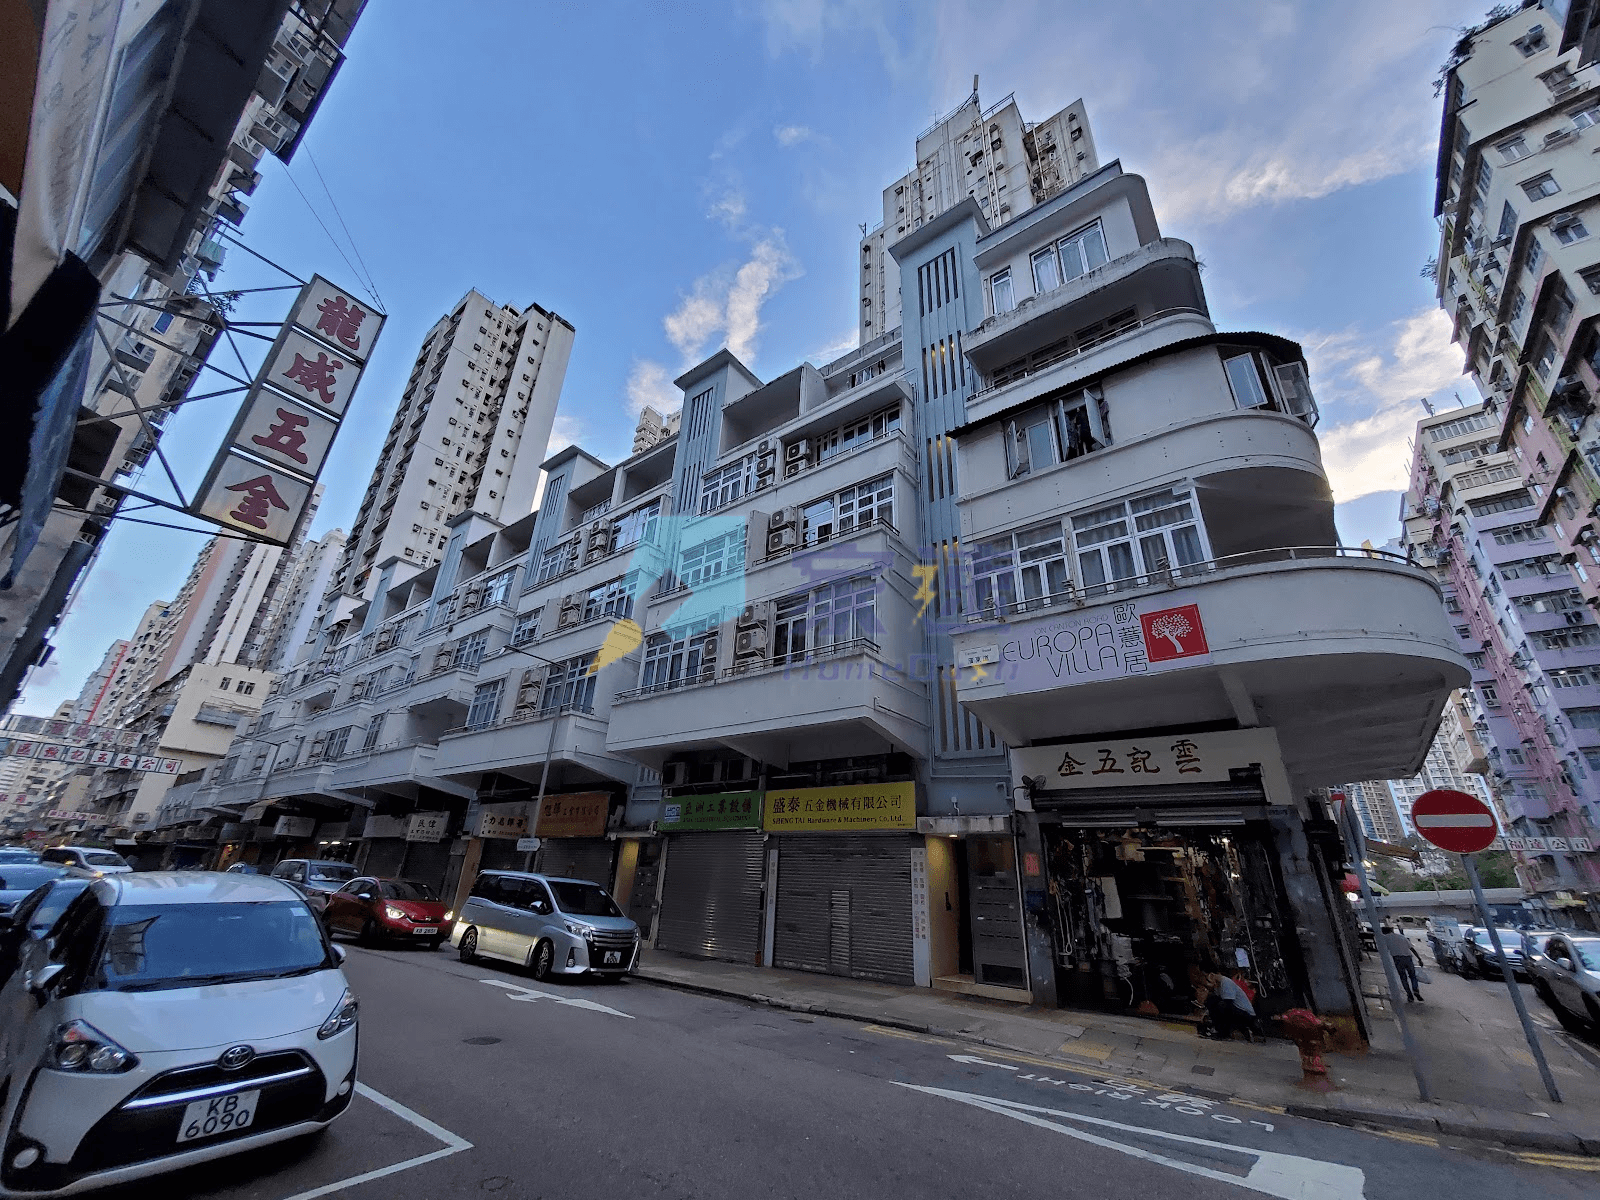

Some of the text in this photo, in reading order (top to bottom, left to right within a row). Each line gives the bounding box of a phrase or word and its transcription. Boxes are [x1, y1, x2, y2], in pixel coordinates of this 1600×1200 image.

[225, 295, 367, 530] 龍威五金
[1034, 627, 1047, 636] ON
[1048, 618, 1082, 632] CANTON
[1002, 622, 1116, 663] EUROPA
[1046, 645, 1120, 678] VILLA
[773, 795, 902, 814] 盛泰五金機械有限公司
[207, 1095, 239, 1117] KB
[185, 1109, 250, 1139] 6090
